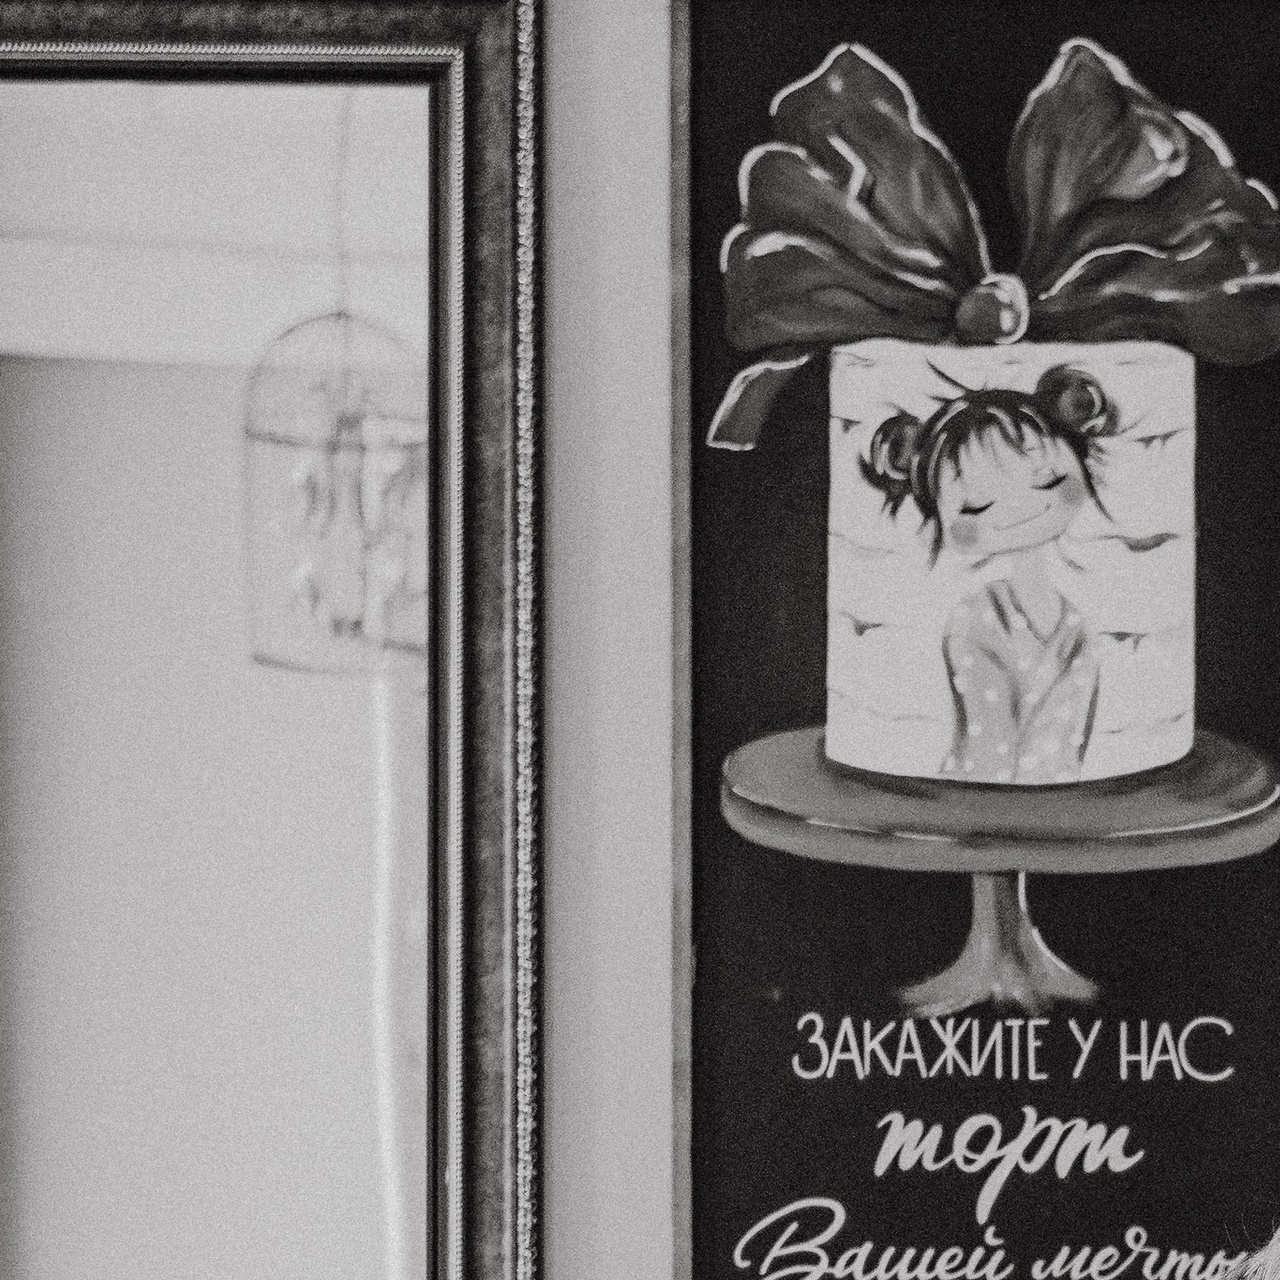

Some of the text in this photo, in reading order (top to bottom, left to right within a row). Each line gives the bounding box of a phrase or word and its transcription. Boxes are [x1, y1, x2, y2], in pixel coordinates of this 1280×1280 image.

[791, 1011, 1235, 1083] ЗАКАЖИТЕ У НАС
[873, 1105, 1146, 1226] торт
